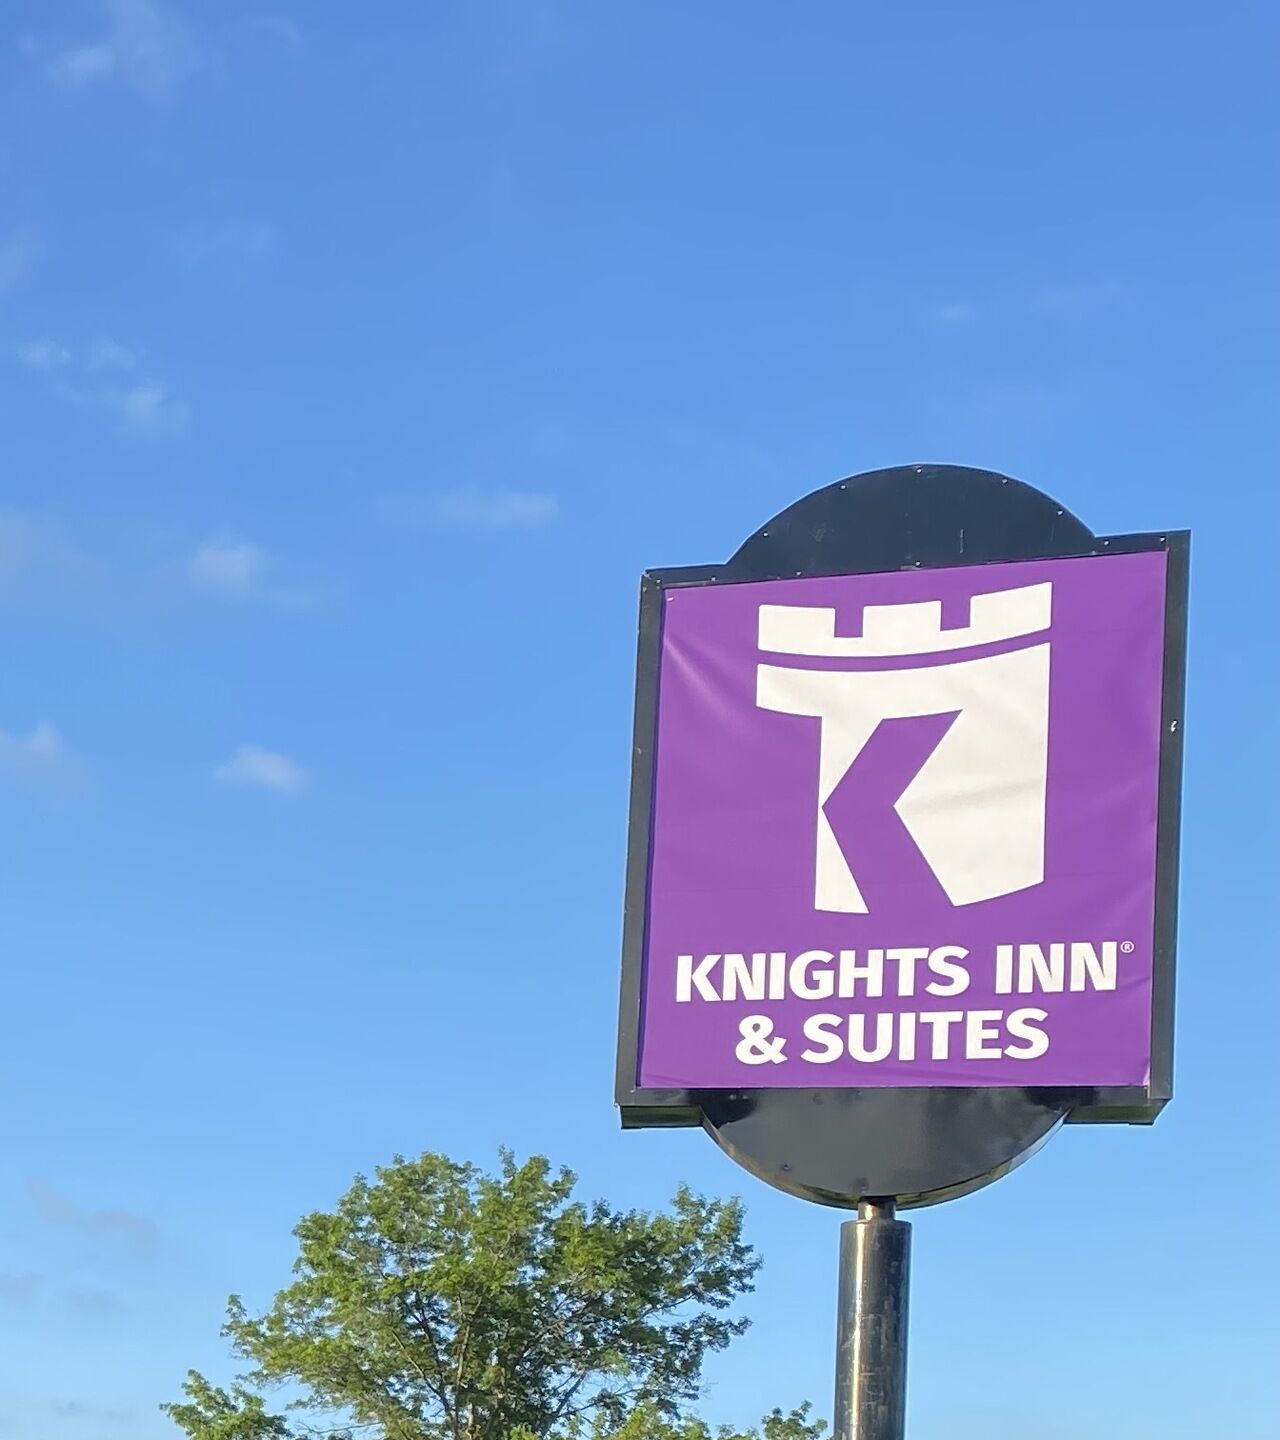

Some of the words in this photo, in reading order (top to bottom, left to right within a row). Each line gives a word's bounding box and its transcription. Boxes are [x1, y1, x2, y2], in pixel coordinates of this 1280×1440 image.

[675, 945, 971, 1003] KNIGHTS
[735, 1014, 788, 1065] &
[800, 1007, 1050, 1064] SUITES
